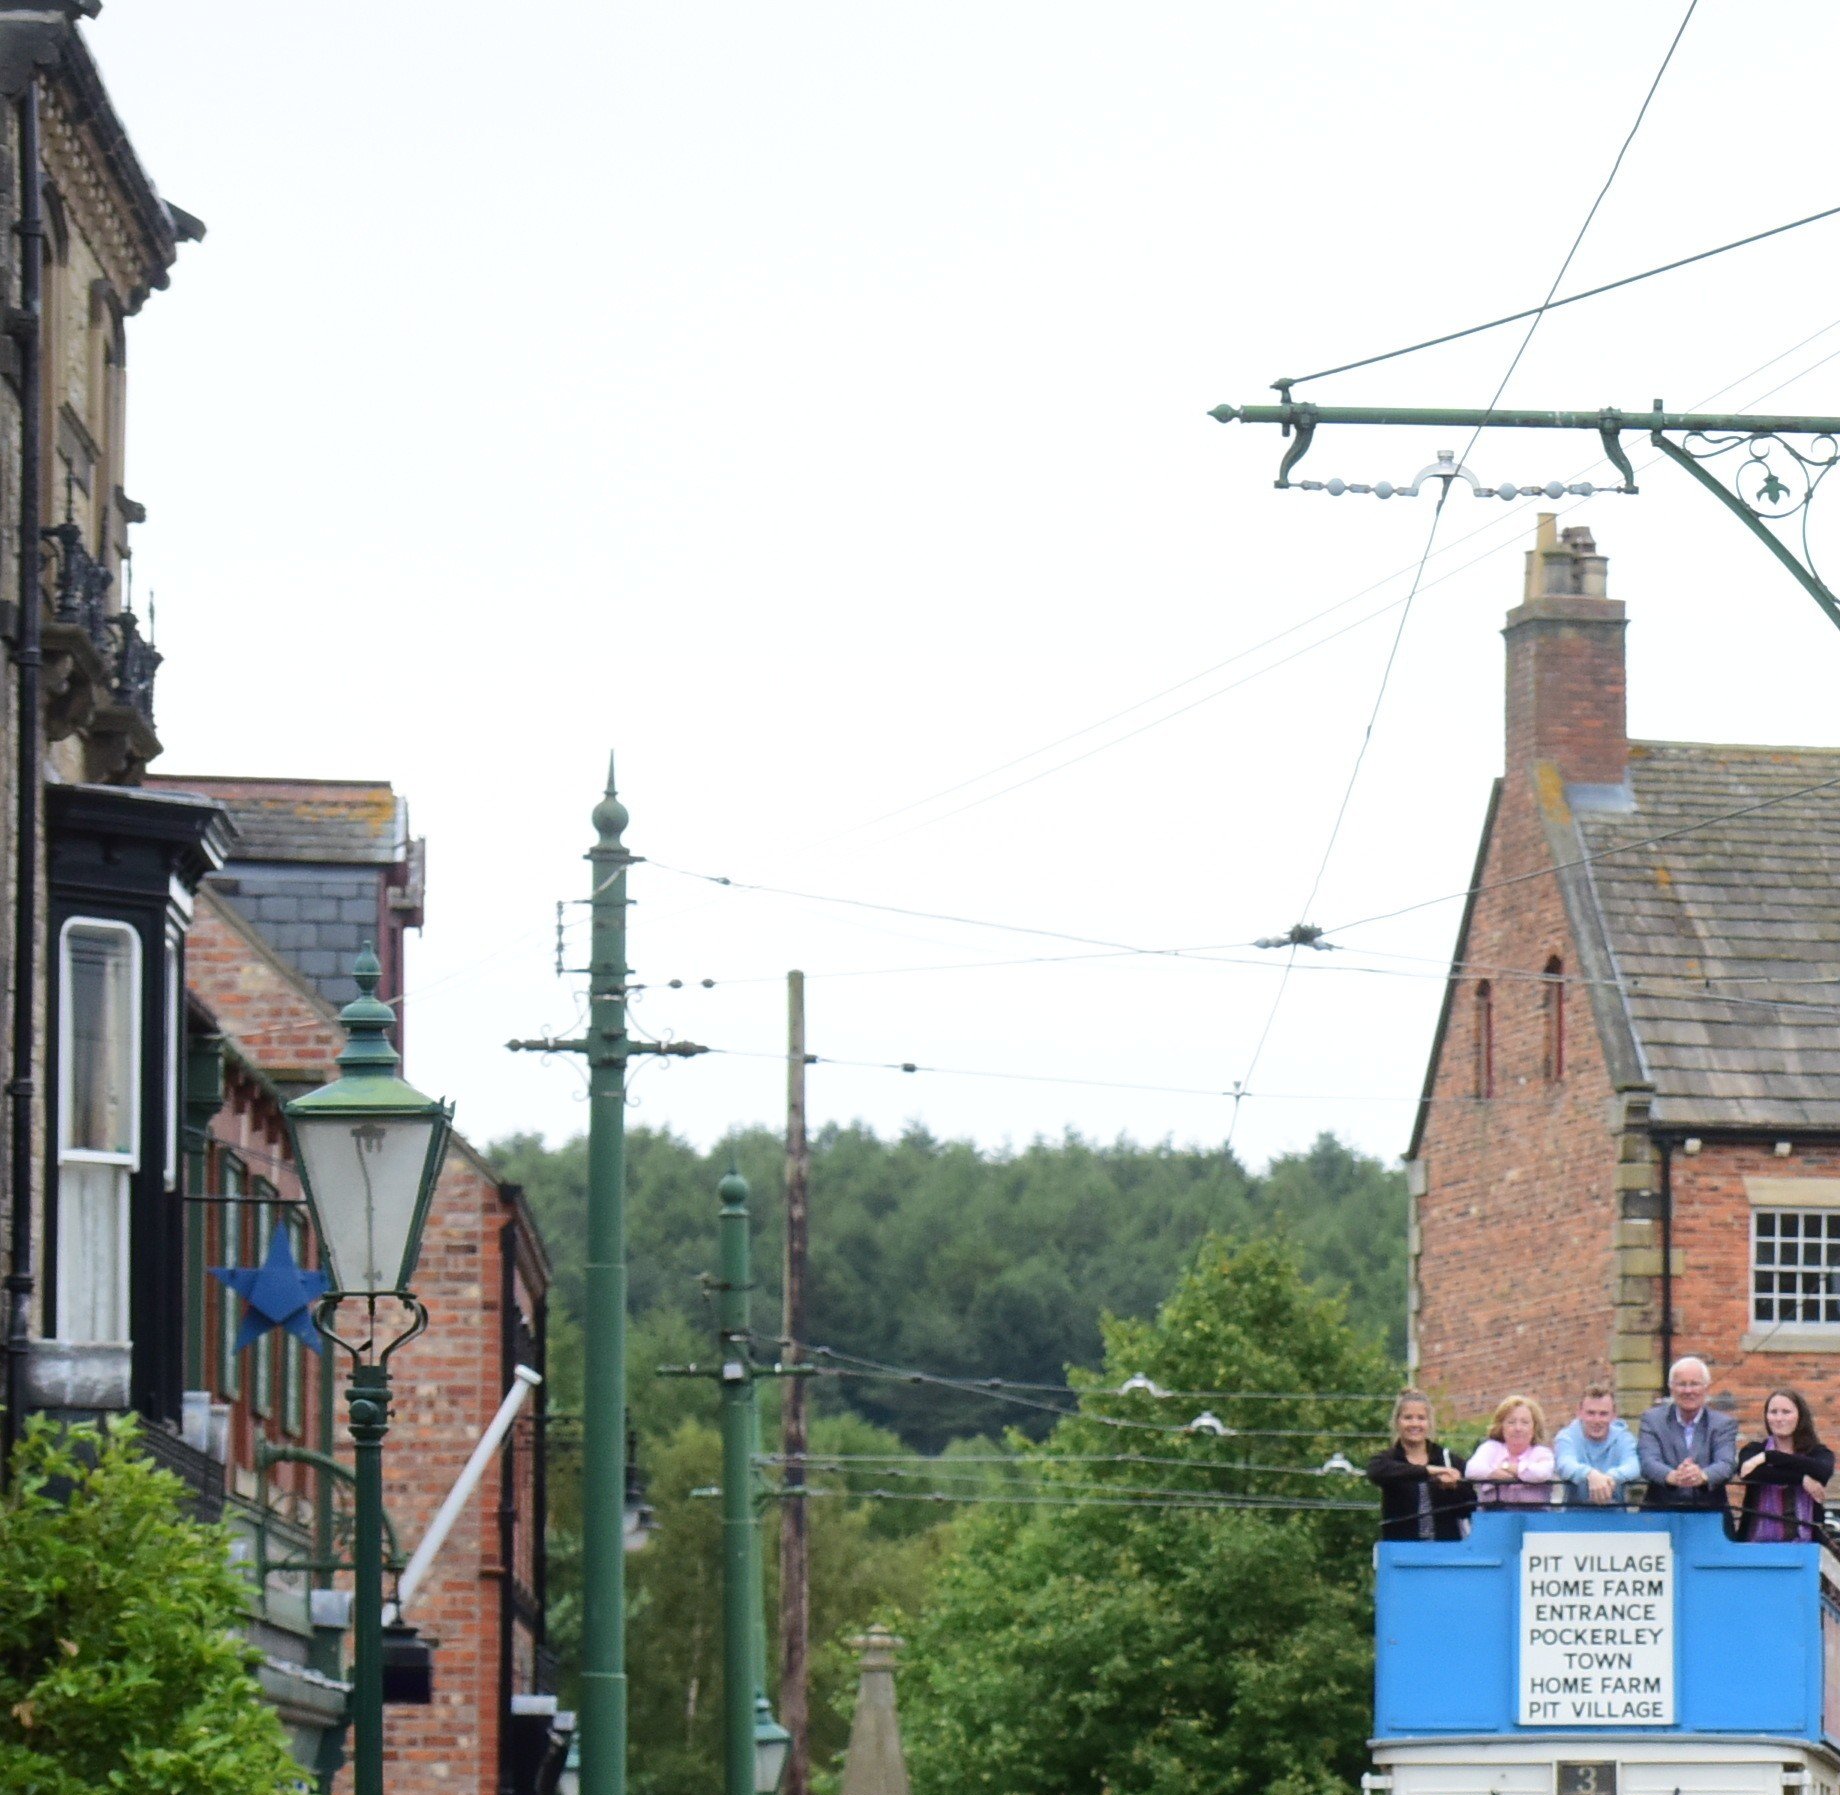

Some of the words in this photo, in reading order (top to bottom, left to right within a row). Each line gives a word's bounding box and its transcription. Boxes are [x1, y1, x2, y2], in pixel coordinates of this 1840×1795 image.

[1529, 1555, 1563, 1573] PIT
[1574, 1555, 1667, 1573] VILLAGE
[1530, 1580, 1594, 1597] HOME
[1603, 1580, 1664, 1597] FARM
[1535, 1604, 1656, 1621] ENTRANCE
[1529, 1628, 1664, 1646] POCKERLEY
[1563, 1652, 1633, 1670] TOWN
[1530, 1677, 1593, 1695] HOME
[1600, 1677, 1661, 1695] FARM
[1529, 1701, 1561, 1719] PIT
[1571, 1701, 1664, 1719] VILLAGE
[1575, 1767, 1597, 1795] 3
